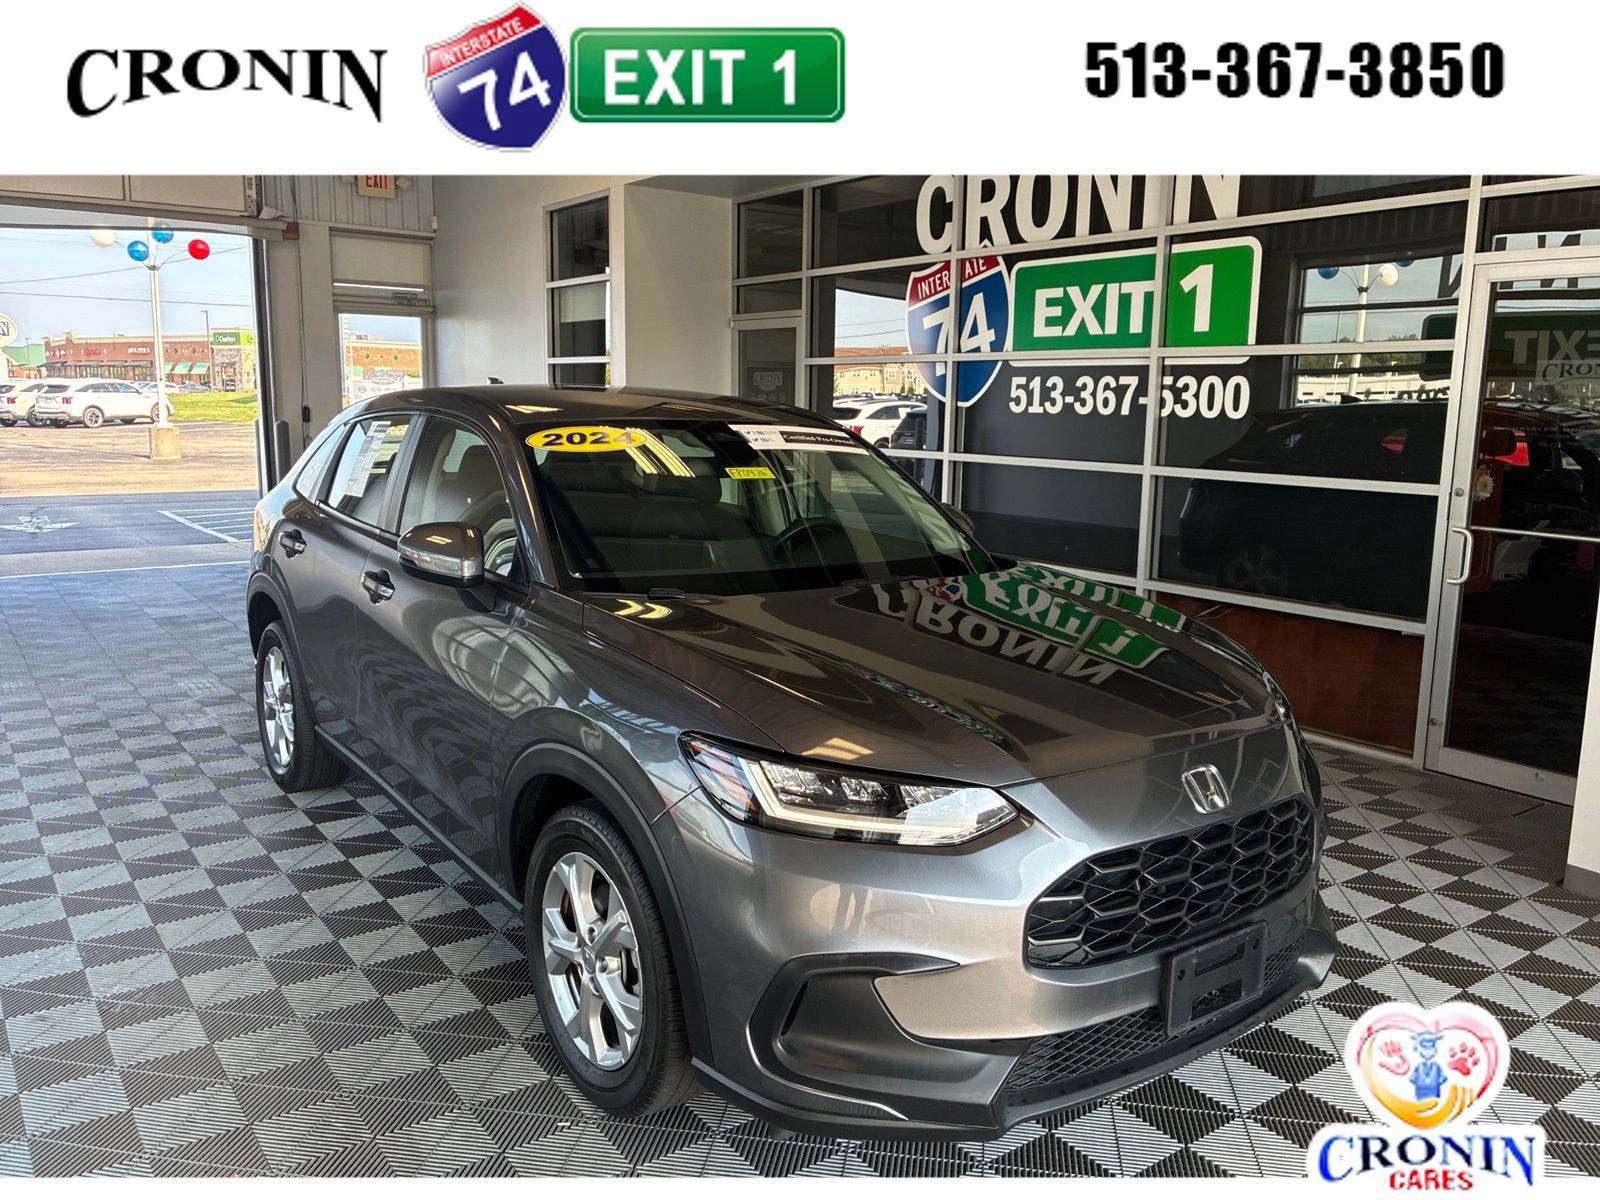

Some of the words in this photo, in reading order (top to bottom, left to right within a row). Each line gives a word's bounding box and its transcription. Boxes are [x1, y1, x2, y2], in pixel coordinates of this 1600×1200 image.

[916, 175, 1240, 255] CRONIN
[922, 291, 996, 377] 74
[1033, 280, 1156, 338] EXIT
[1179, 263, 1214, 333] 1
[1008, 375, 1251, 420] 513-367-5300
[541, 431, 637, 447] 2024
